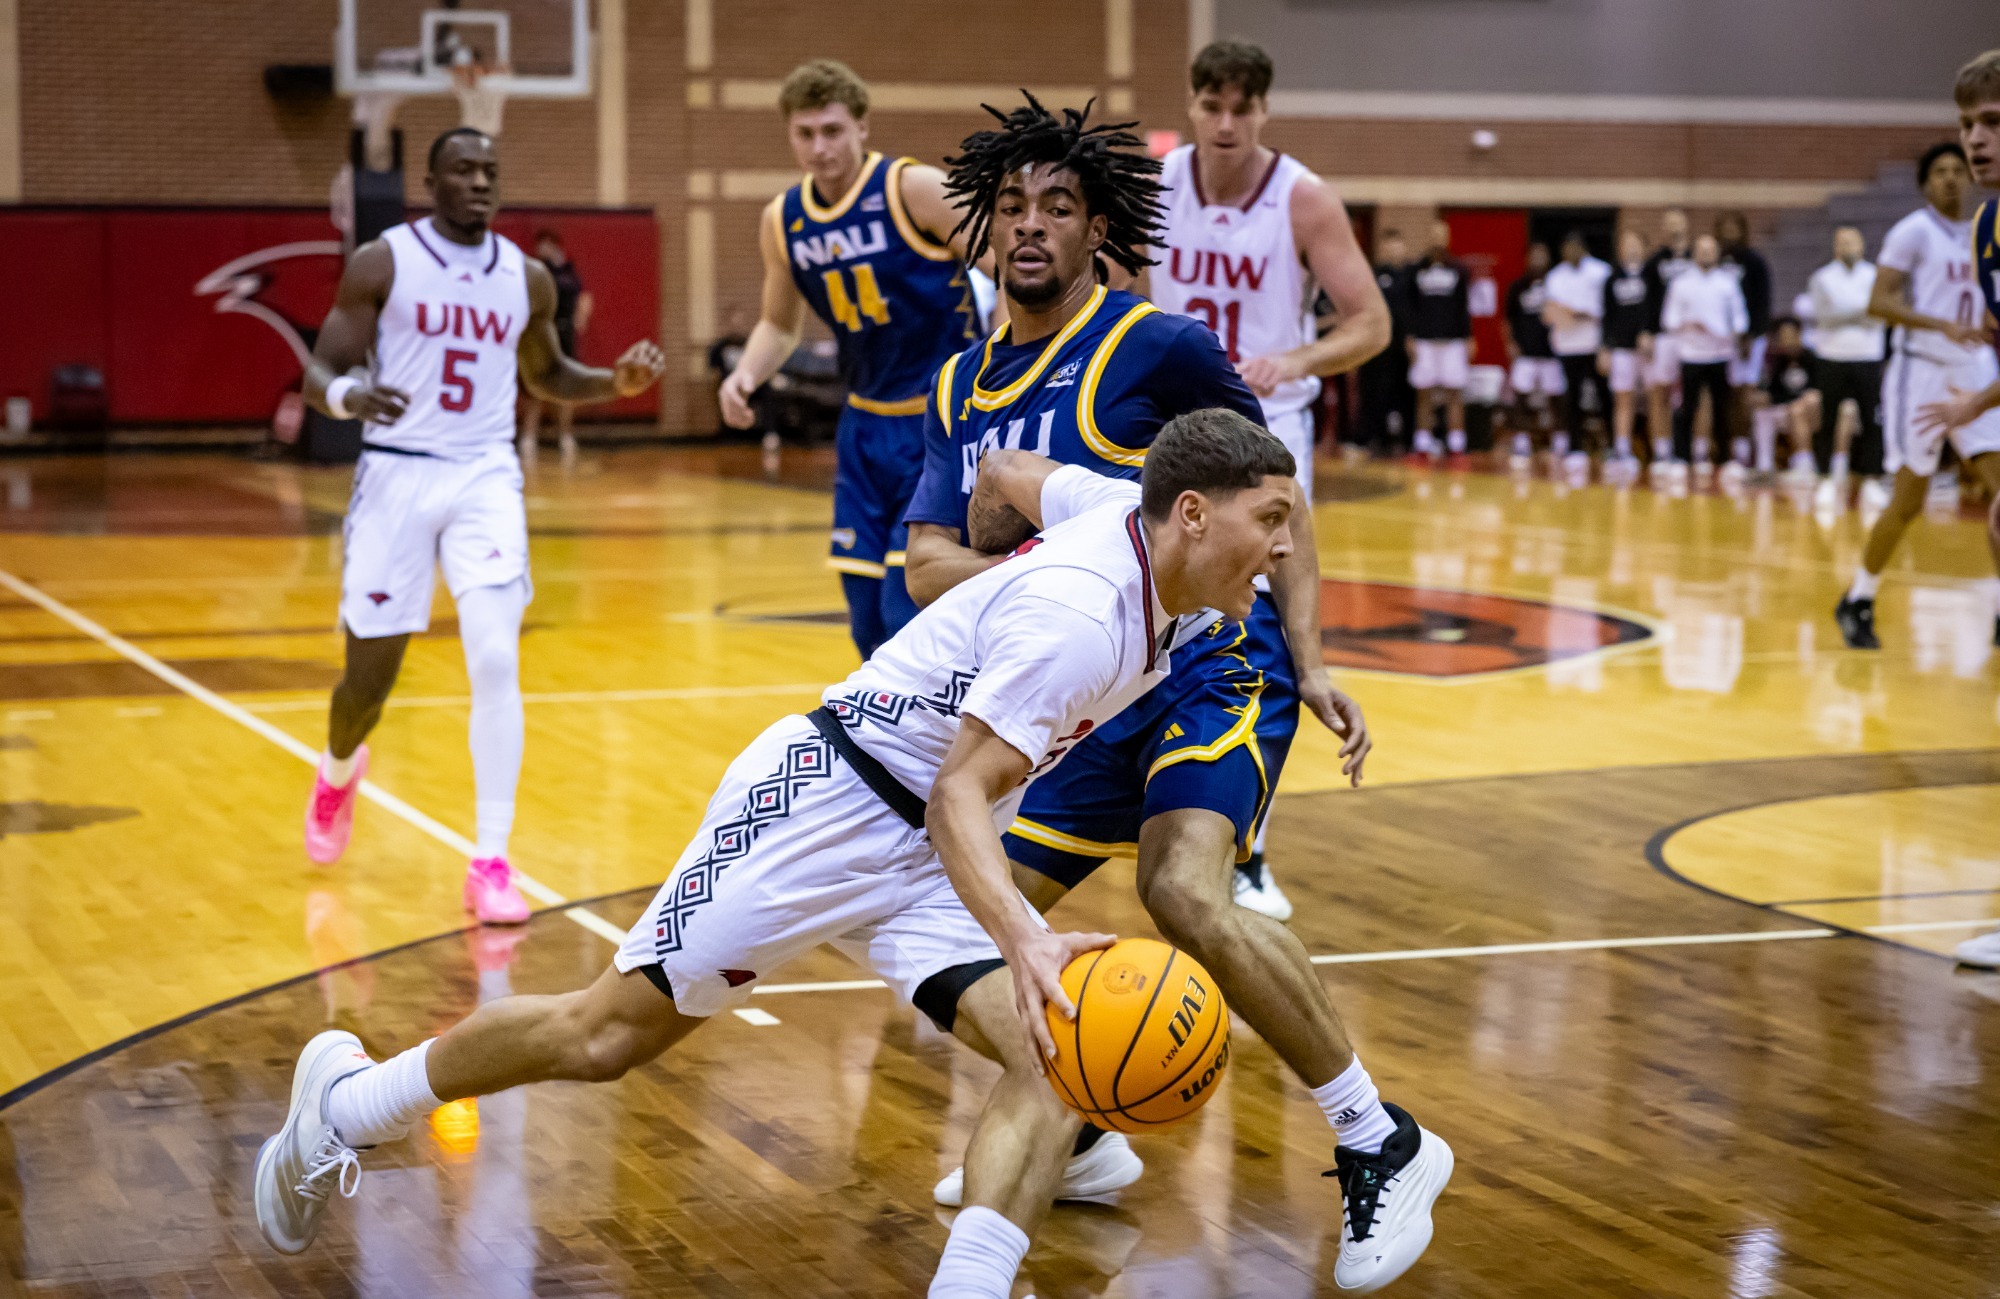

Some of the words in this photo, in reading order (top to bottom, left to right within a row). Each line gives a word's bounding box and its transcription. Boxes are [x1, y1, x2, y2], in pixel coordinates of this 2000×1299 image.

[792, 220, 888, 271] NAU
[1170, 247, 1268, 291] UIW
[822, 262, 891, 332] 44
[417, 302, 513, 345] UIW
[439, 347, 478, 414] 5
[1167, 974, 1206, 1049] EVO
[1161, 1045, 1179, 1069] NXT
